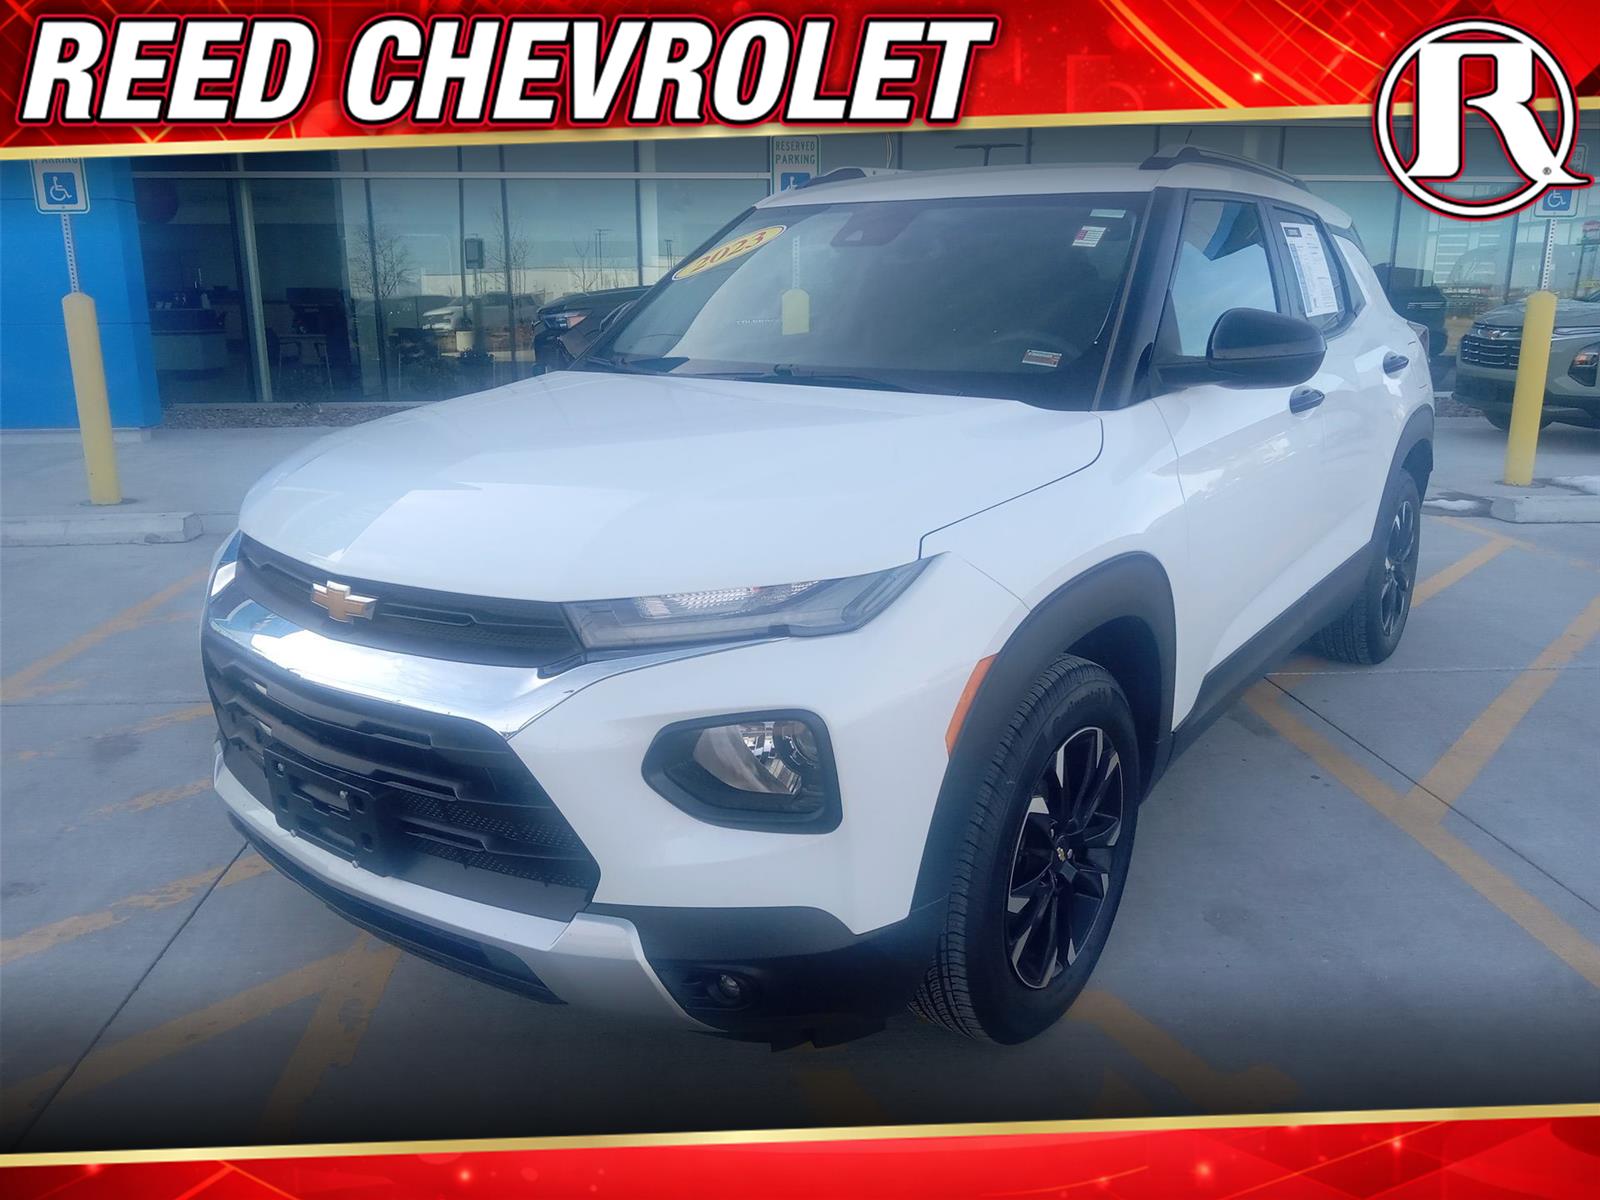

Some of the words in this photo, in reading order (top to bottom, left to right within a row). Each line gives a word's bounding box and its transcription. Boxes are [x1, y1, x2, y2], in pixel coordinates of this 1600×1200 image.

[775, 141, 816, 151] RESERVED
[775, 154, 816, 165] PARKING
[690, 231, 767, 273] 2023
